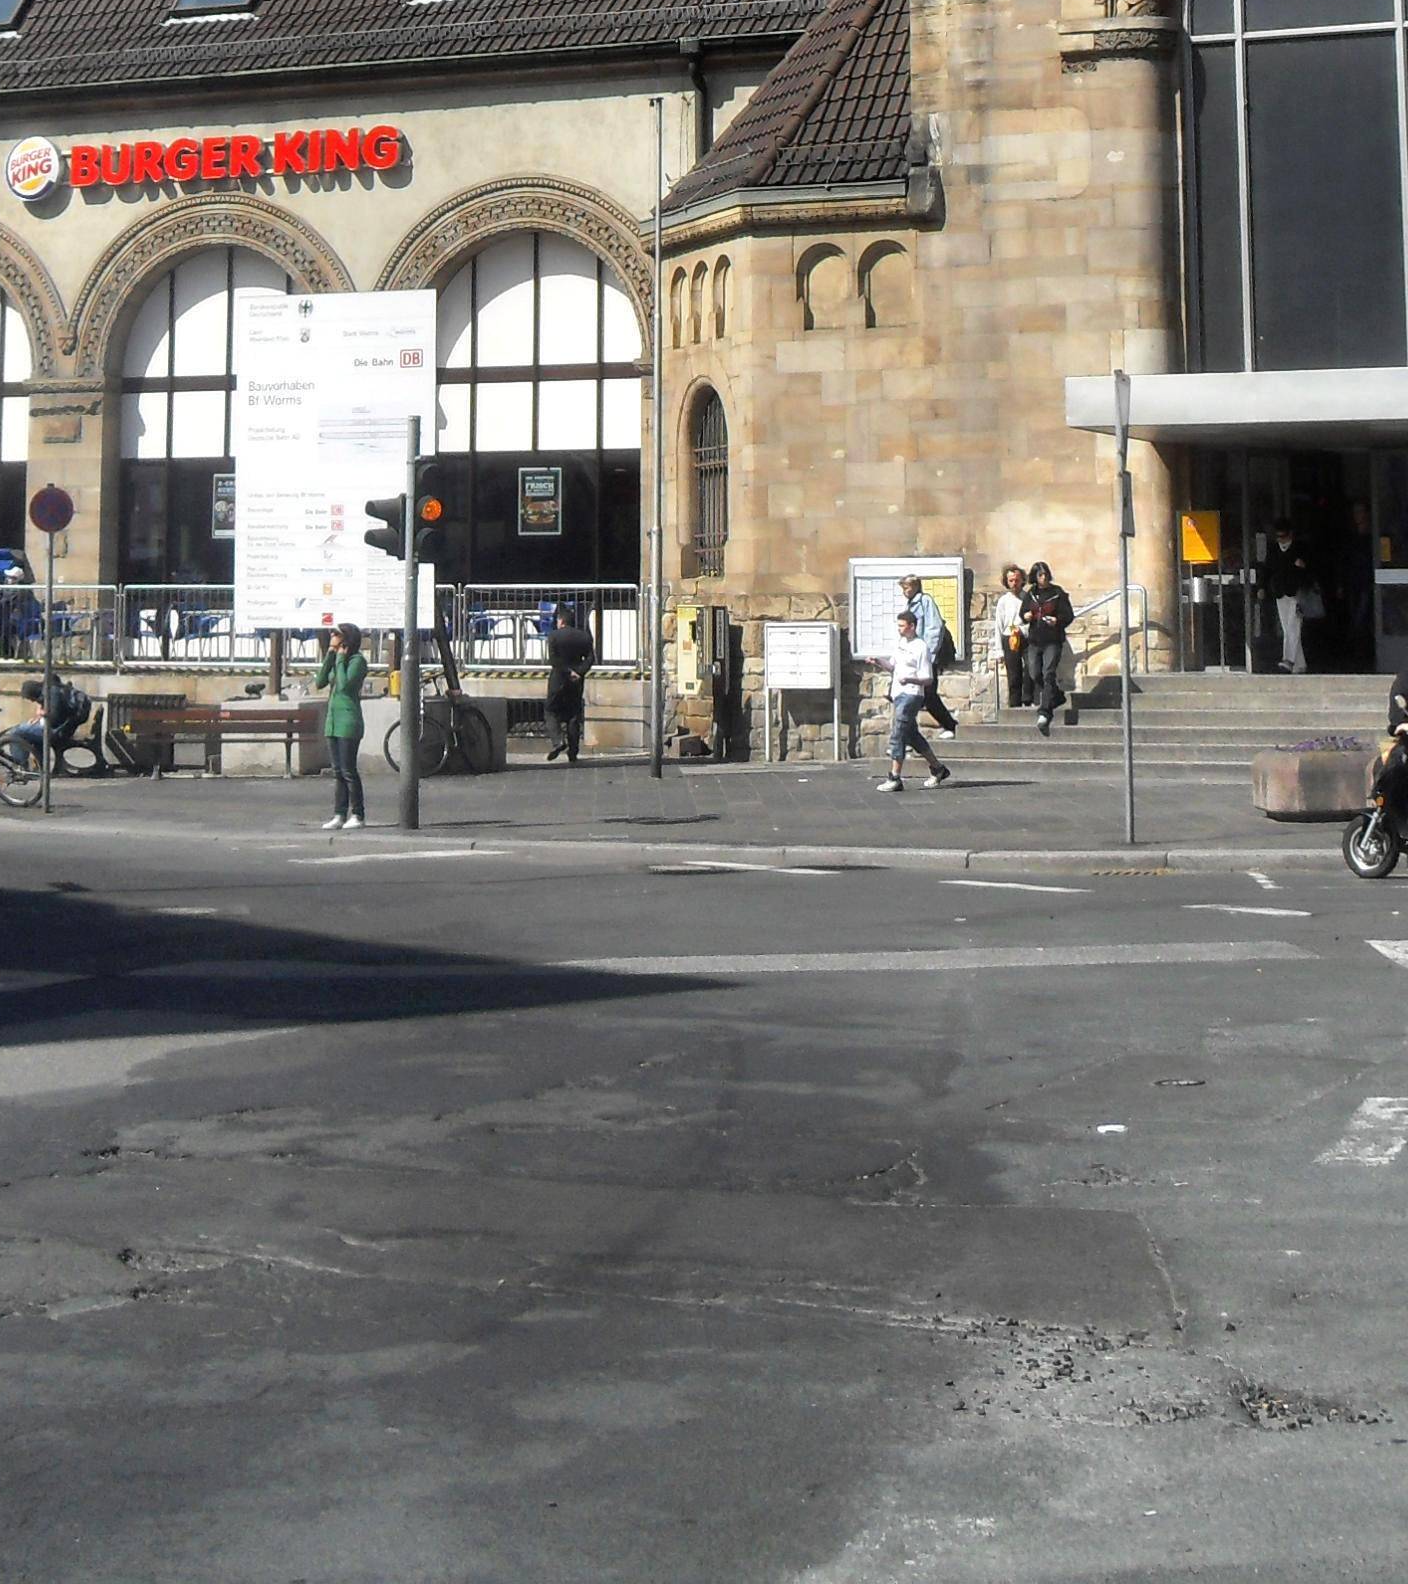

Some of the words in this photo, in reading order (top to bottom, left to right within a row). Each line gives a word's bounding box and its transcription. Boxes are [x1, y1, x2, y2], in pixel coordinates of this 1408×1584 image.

[9, 146, 52, 169] BURGER
[70, 135, 263, 188] BURGER
[274, 125, 402, 176] KING
[11, 157, 53, 185] KING
[353, 358, 369, 367] Die
[371, 357, 394, 367] Bahn
[402, 351, 421, 366] DB
[248, 380, 315, 392] Bauvorhaben
[263, 394, 303, 406] Worms
